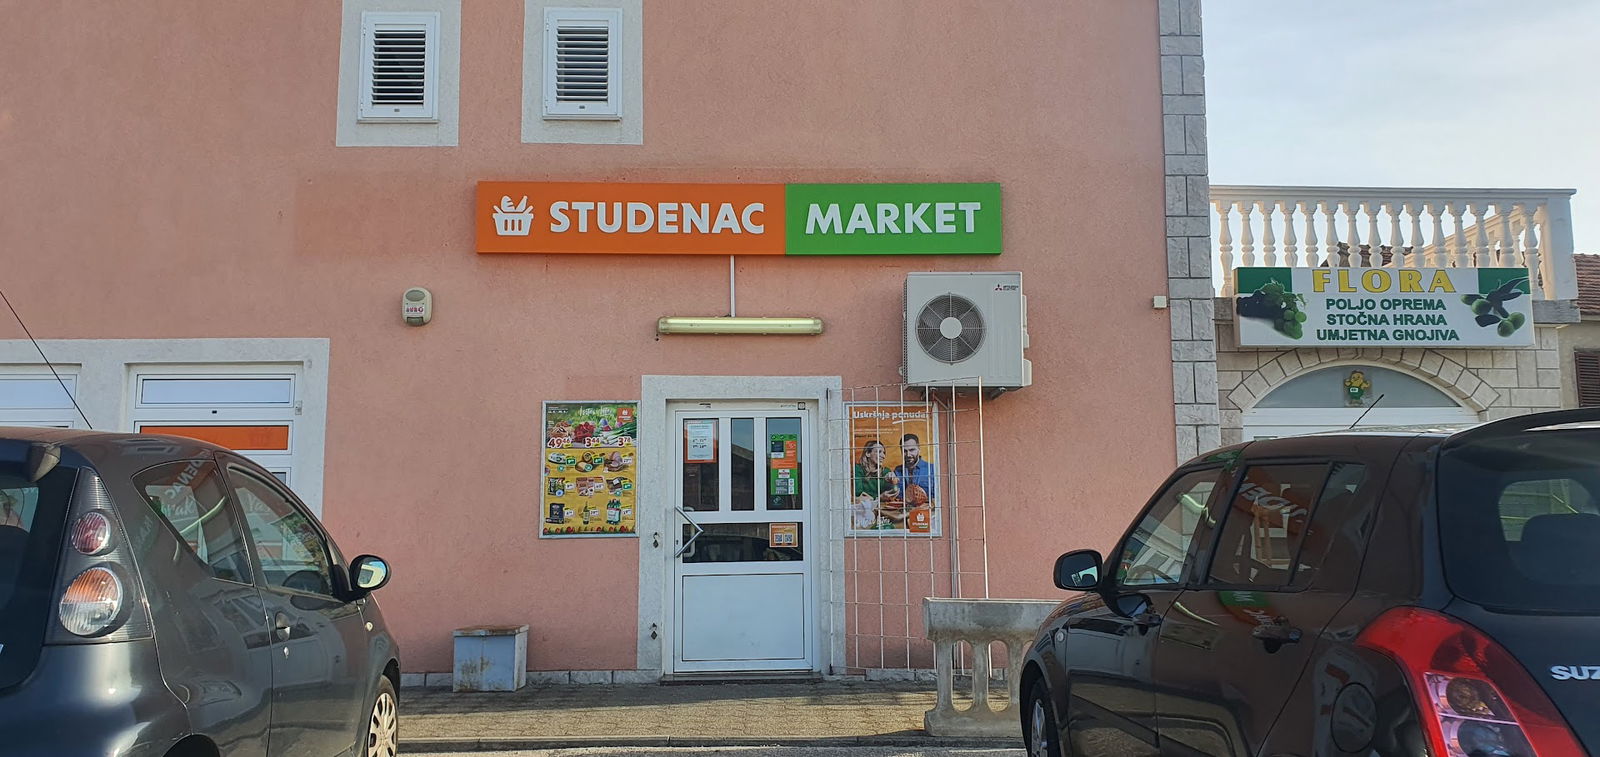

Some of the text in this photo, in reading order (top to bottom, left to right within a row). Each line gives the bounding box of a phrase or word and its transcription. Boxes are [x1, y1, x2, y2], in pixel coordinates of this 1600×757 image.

[550, 202, 981, 234] STUDENAC MARKET
[1312, 268, 1456, 293] FLORA
[1326, 299, 1446, 311] POLJO OPREMA
[1327, 311, 1447, 326] STOČNA HRANA
[1317, 329, 1460, 341] UMJETNA GNOJIVA
